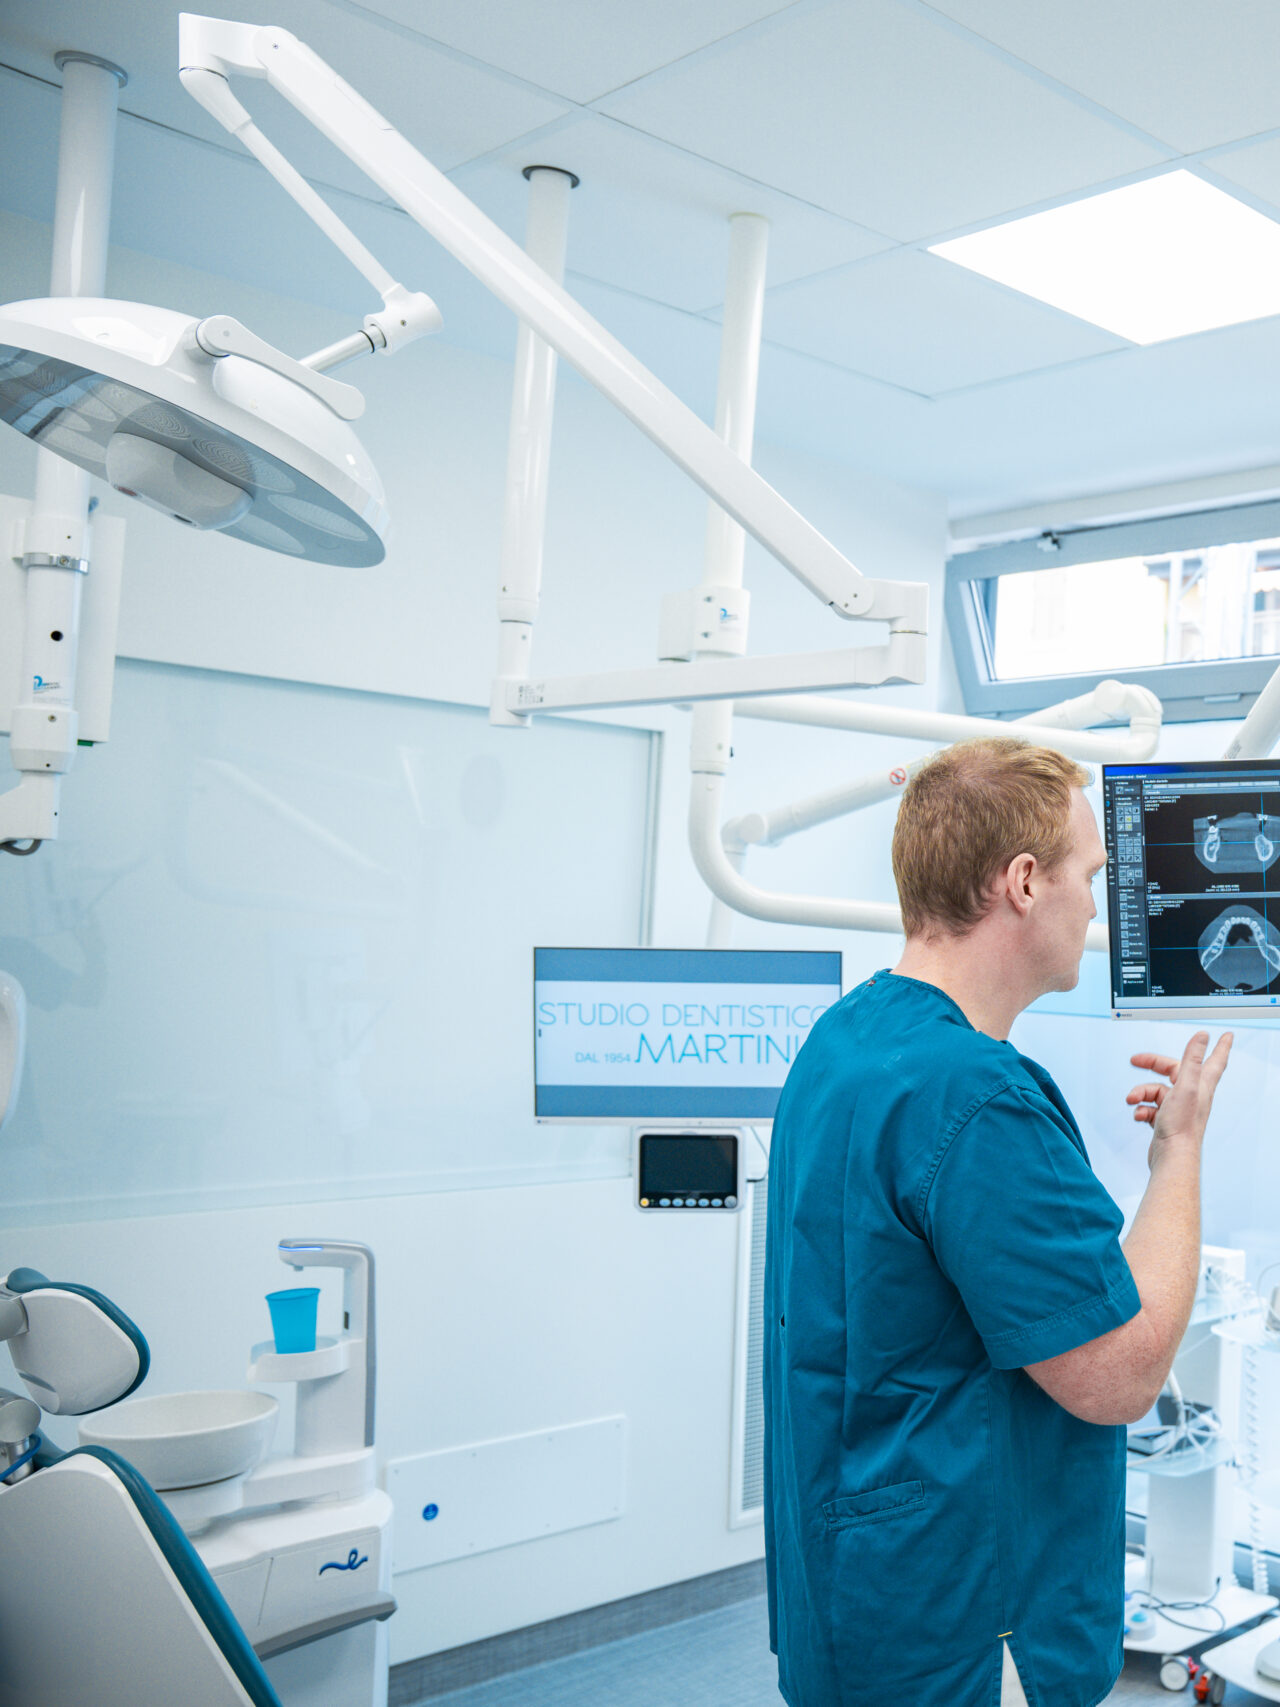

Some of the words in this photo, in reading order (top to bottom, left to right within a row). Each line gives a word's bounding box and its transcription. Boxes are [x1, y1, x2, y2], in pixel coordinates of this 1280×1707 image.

[538, 1002, 650, 1026] STUDIO
[575, 1052, 599, 1063] DAL
[604, 1052, 631, 1063] 1954
[634, 1032, 800, 1064] MARTINI
